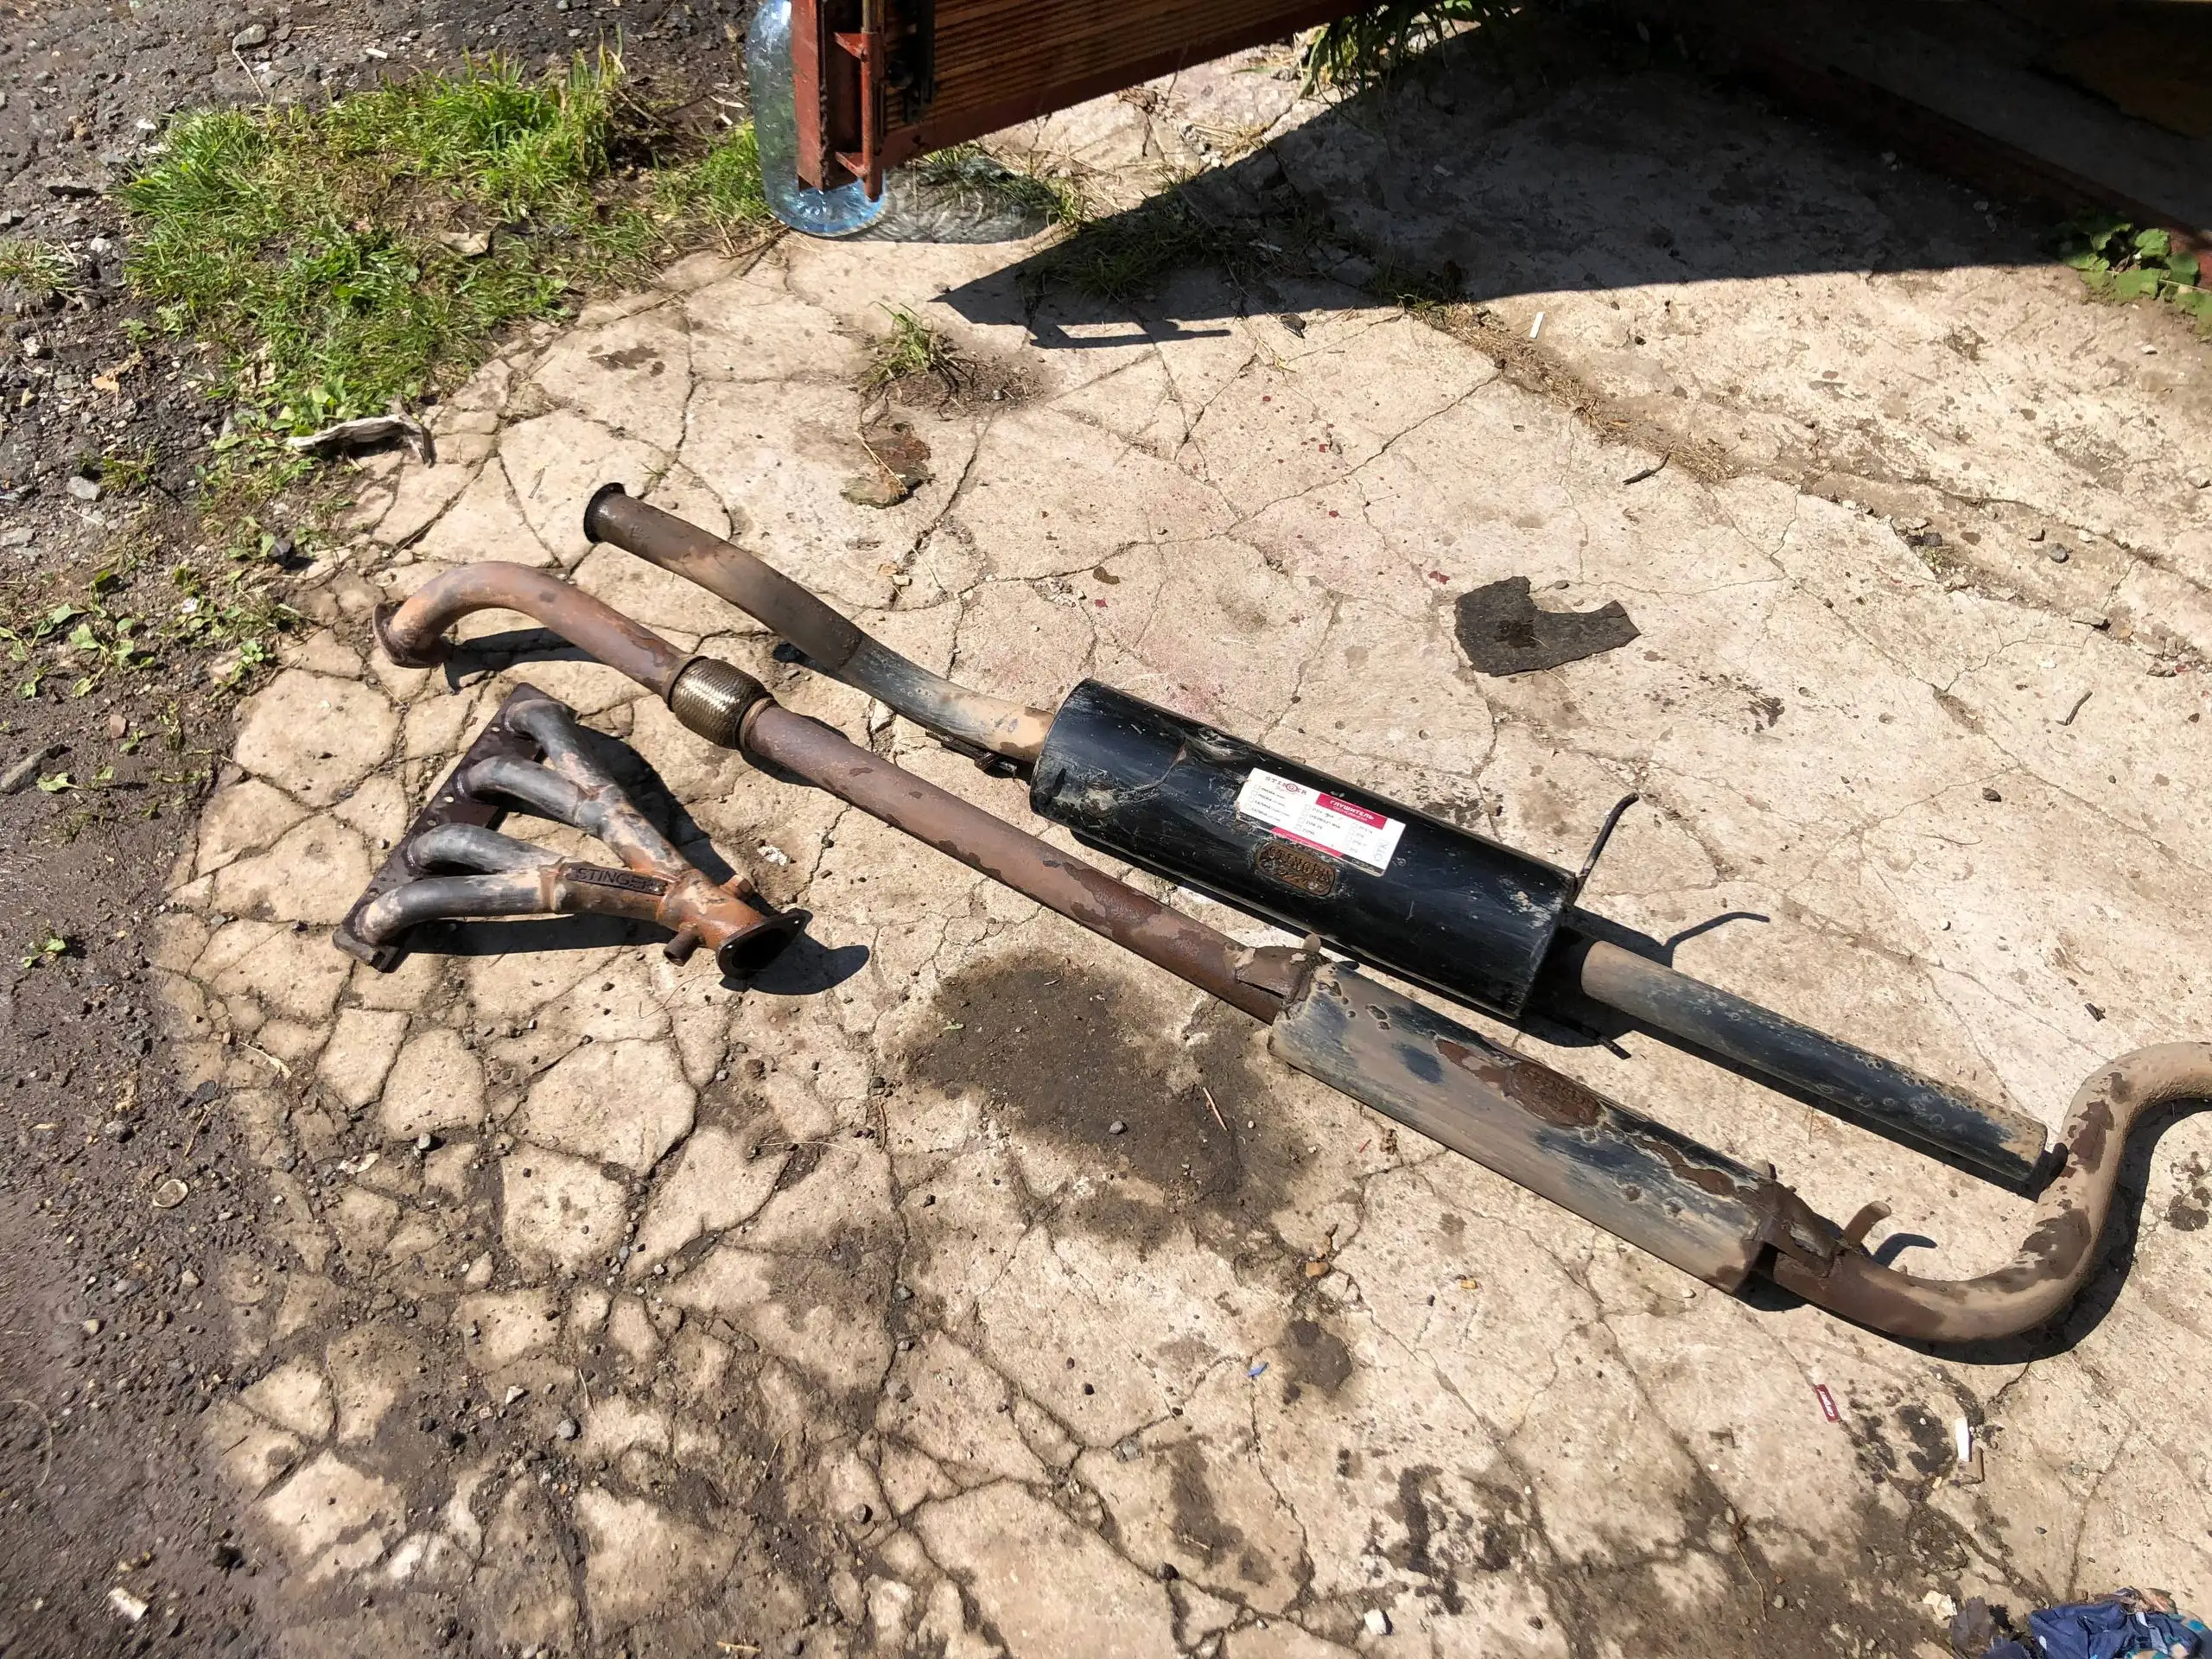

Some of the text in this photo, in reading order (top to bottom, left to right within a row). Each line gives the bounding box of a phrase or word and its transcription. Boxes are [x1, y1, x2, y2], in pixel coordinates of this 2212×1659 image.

[1264, 775, 1307, 796] STINGER
[1330, 799, 1374, 820] ГЛУШИТЕЛЬ
[576, 868, 654, 891] STINGER
